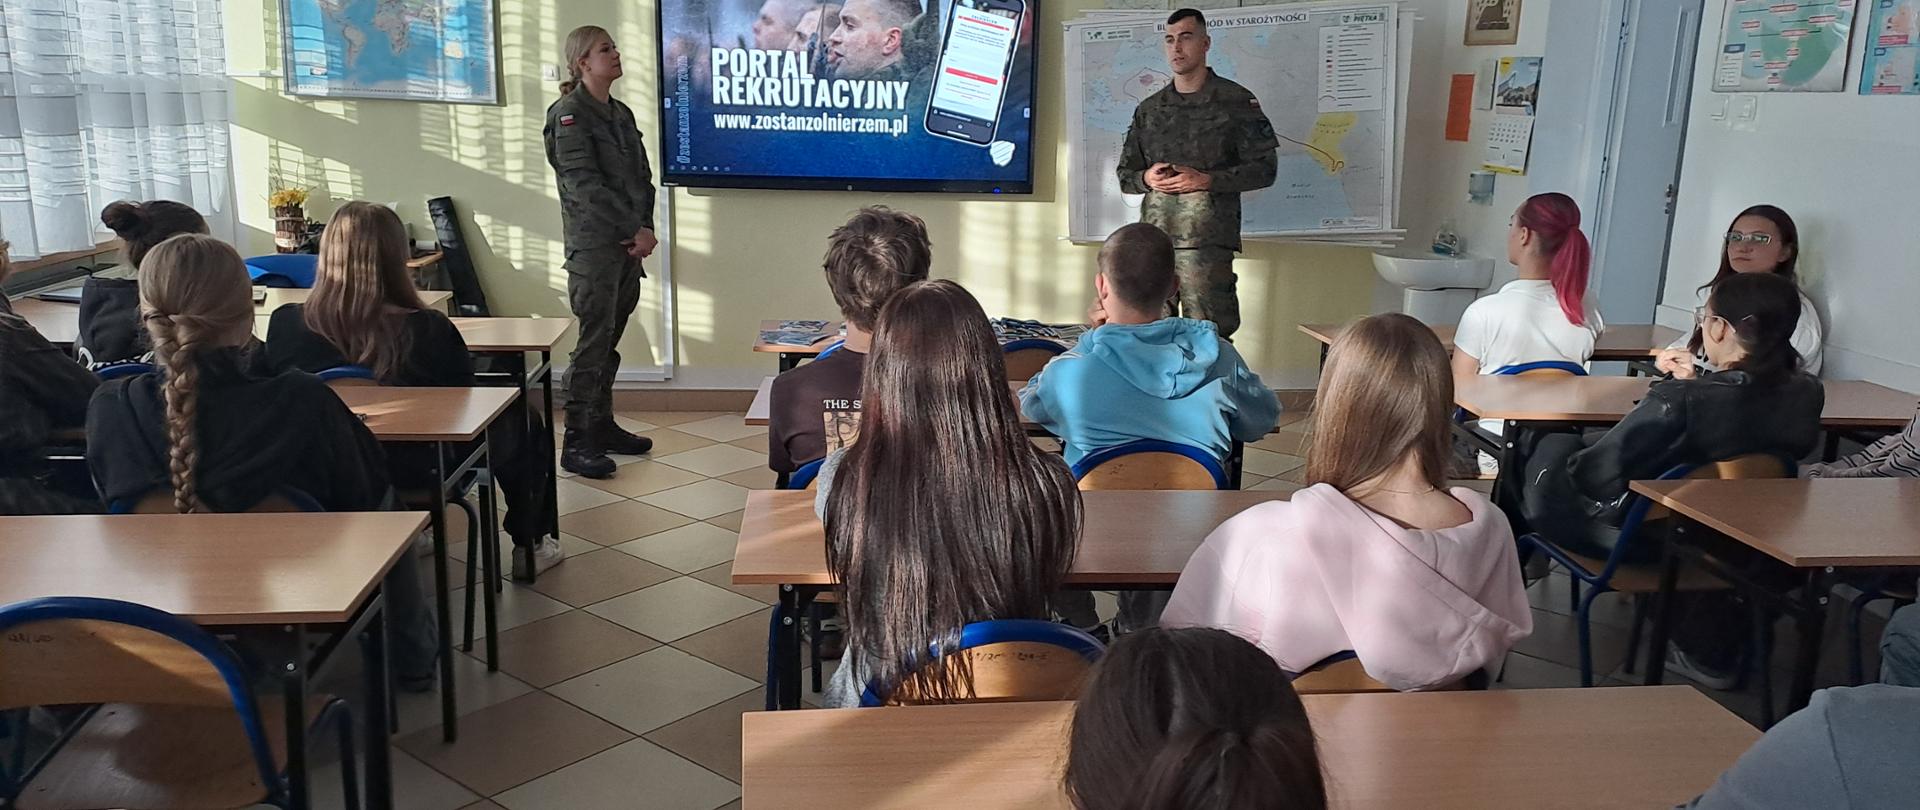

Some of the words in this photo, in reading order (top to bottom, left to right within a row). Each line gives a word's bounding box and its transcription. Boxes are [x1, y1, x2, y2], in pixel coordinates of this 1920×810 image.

[1236, 13, 1307, 25] STAROŻYTNOŚCI
[711, 47, 813, 79] PORTAL
[712, 75, 909, 110] REKRUTACYJNY
[714, 112, 908, 137] www.zostanzolnierzem.pl
[823, 399, 849, 409] THE
